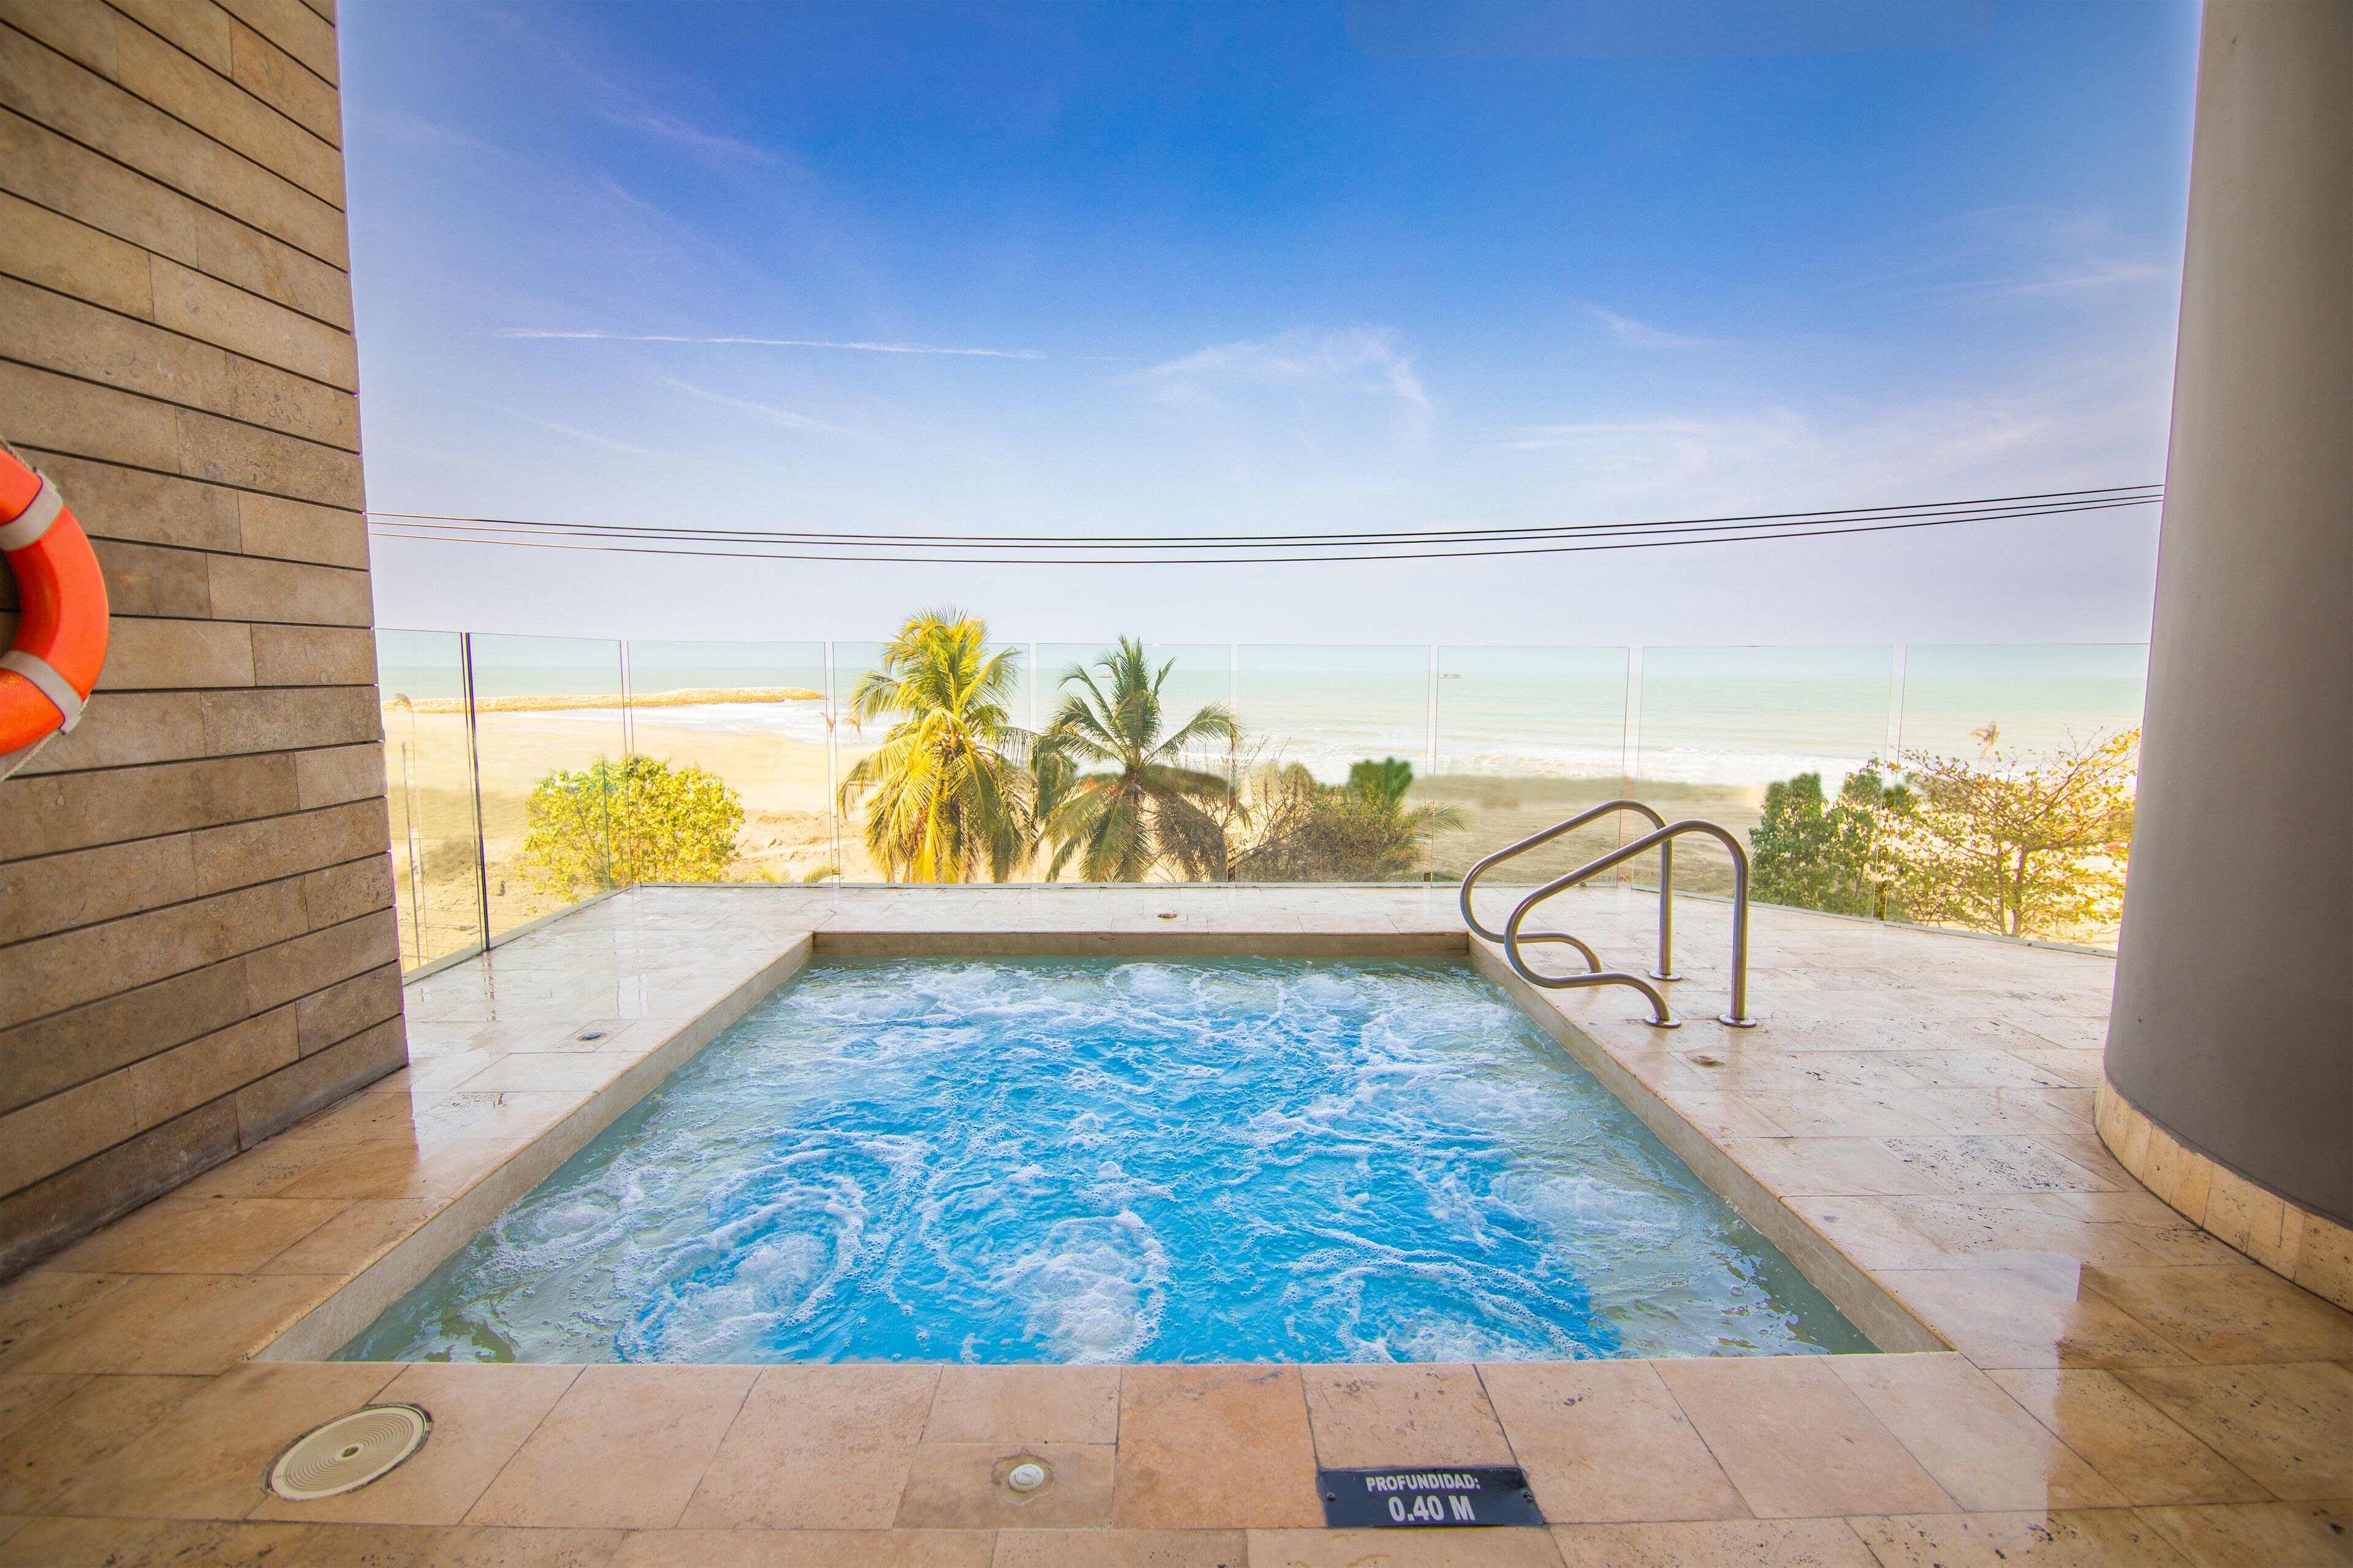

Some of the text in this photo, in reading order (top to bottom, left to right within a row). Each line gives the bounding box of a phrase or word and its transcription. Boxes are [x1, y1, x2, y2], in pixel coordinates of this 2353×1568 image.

[1366, 1474, 1480, 1491] PROFUNDIDAD:
[1388, 1495, 1476, 1521] 0.40 M
